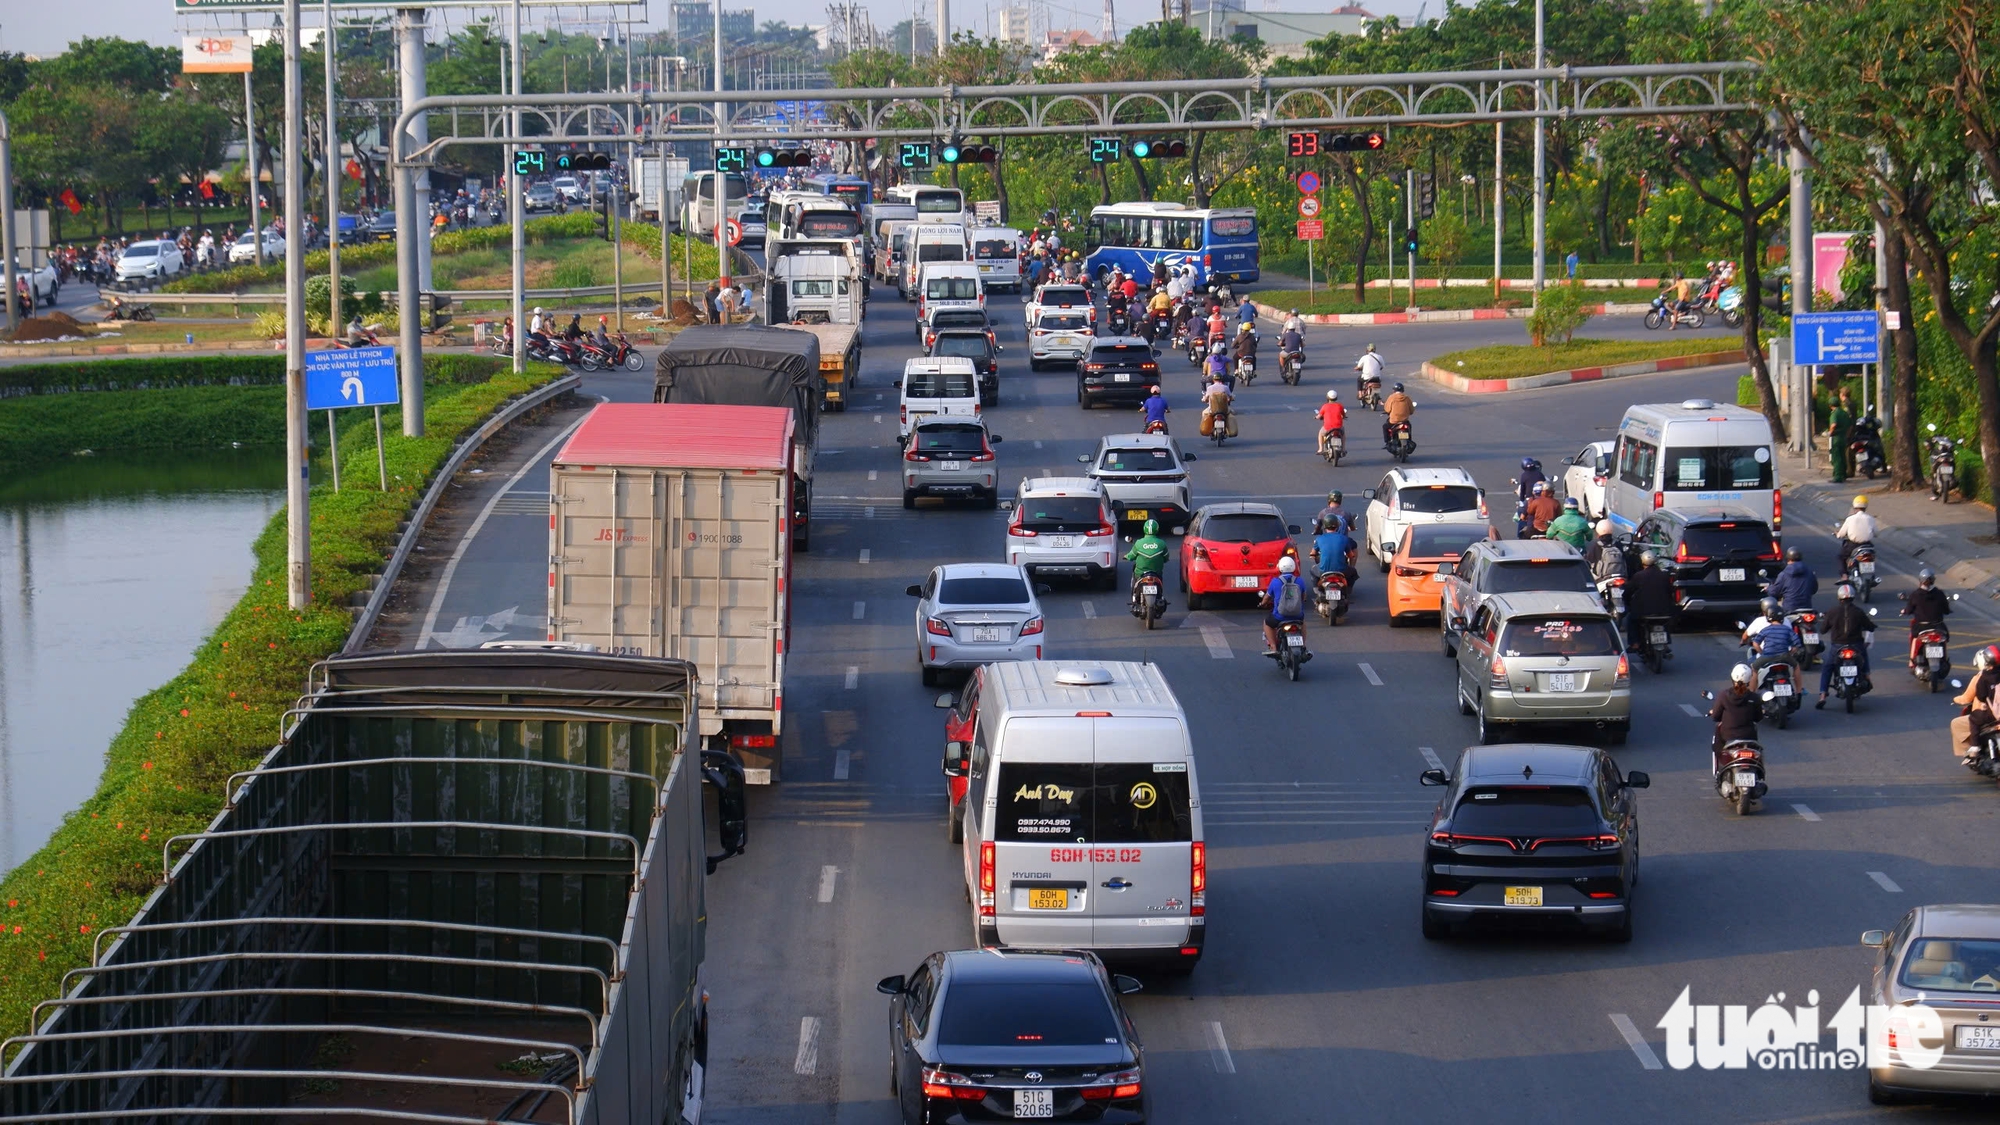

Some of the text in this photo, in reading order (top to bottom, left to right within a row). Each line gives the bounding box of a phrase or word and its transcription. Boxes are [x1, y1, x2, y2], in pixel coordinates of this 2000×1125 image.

[1292, 133, 1317, 156] 33
[902, 143, 930, 167] 24
[1093, 140, 1120, 162] 24
[515, 151, 544, 174] 24
[717, 149, 744, 170] 24
[315, 353, 330, 362] NHÀ
[331, 353, 348, 361] TANG
[317, 364, 330, 372] CỤC
[346, 361, 360, 369] THƯ
[365, 359, 380, 367] LƯU
[594, 529, 627, 541] J&T
[699, 534, 743, 543] 1900 1088
[1555, 675, 1568, 683] 51F
[1550, 683, 1574, 691] 541.97
[1013, 784, 1074, 805] Anh Duy
[1050, 849, 1142, 863] 60H-153.02
[1040, 891, 1057, 899] 60H
[1516, 888, 1532, 896] 50H
[1034, 900, 1064, 908] 153.02
[1510, 897, 1538, 905] 319.73
[1974, 1028, 1994, 1037] 61K
[1966, 1038, 2000, 1048] 357.23
[1023, 1091, 1044, 1103] 51G
[1015, 1104, 1052, 1117] 520.65
